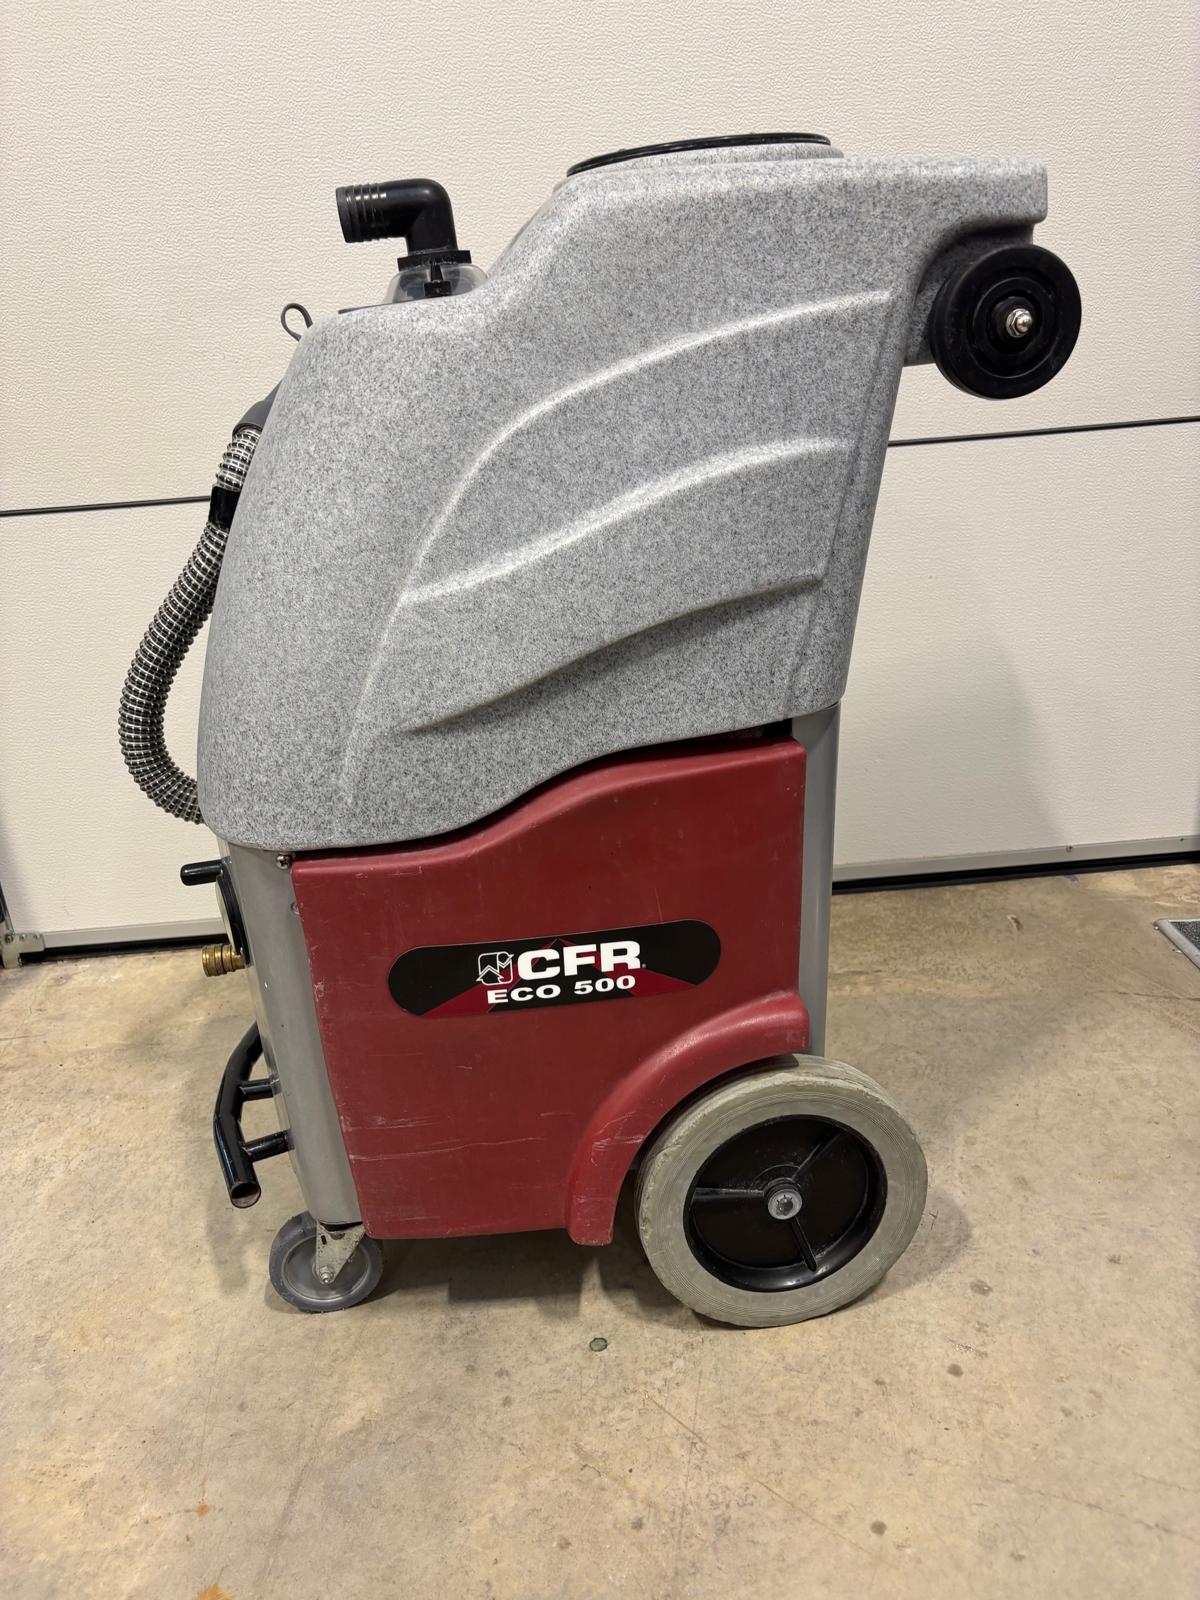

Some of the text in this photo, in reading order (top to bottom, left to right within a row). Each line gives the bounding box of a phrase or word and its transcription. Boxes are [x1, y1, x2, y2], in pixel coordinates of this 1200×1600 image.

[517, 940, 641, 981] CFR
[487, 975, 636, 1004] ECO 500
